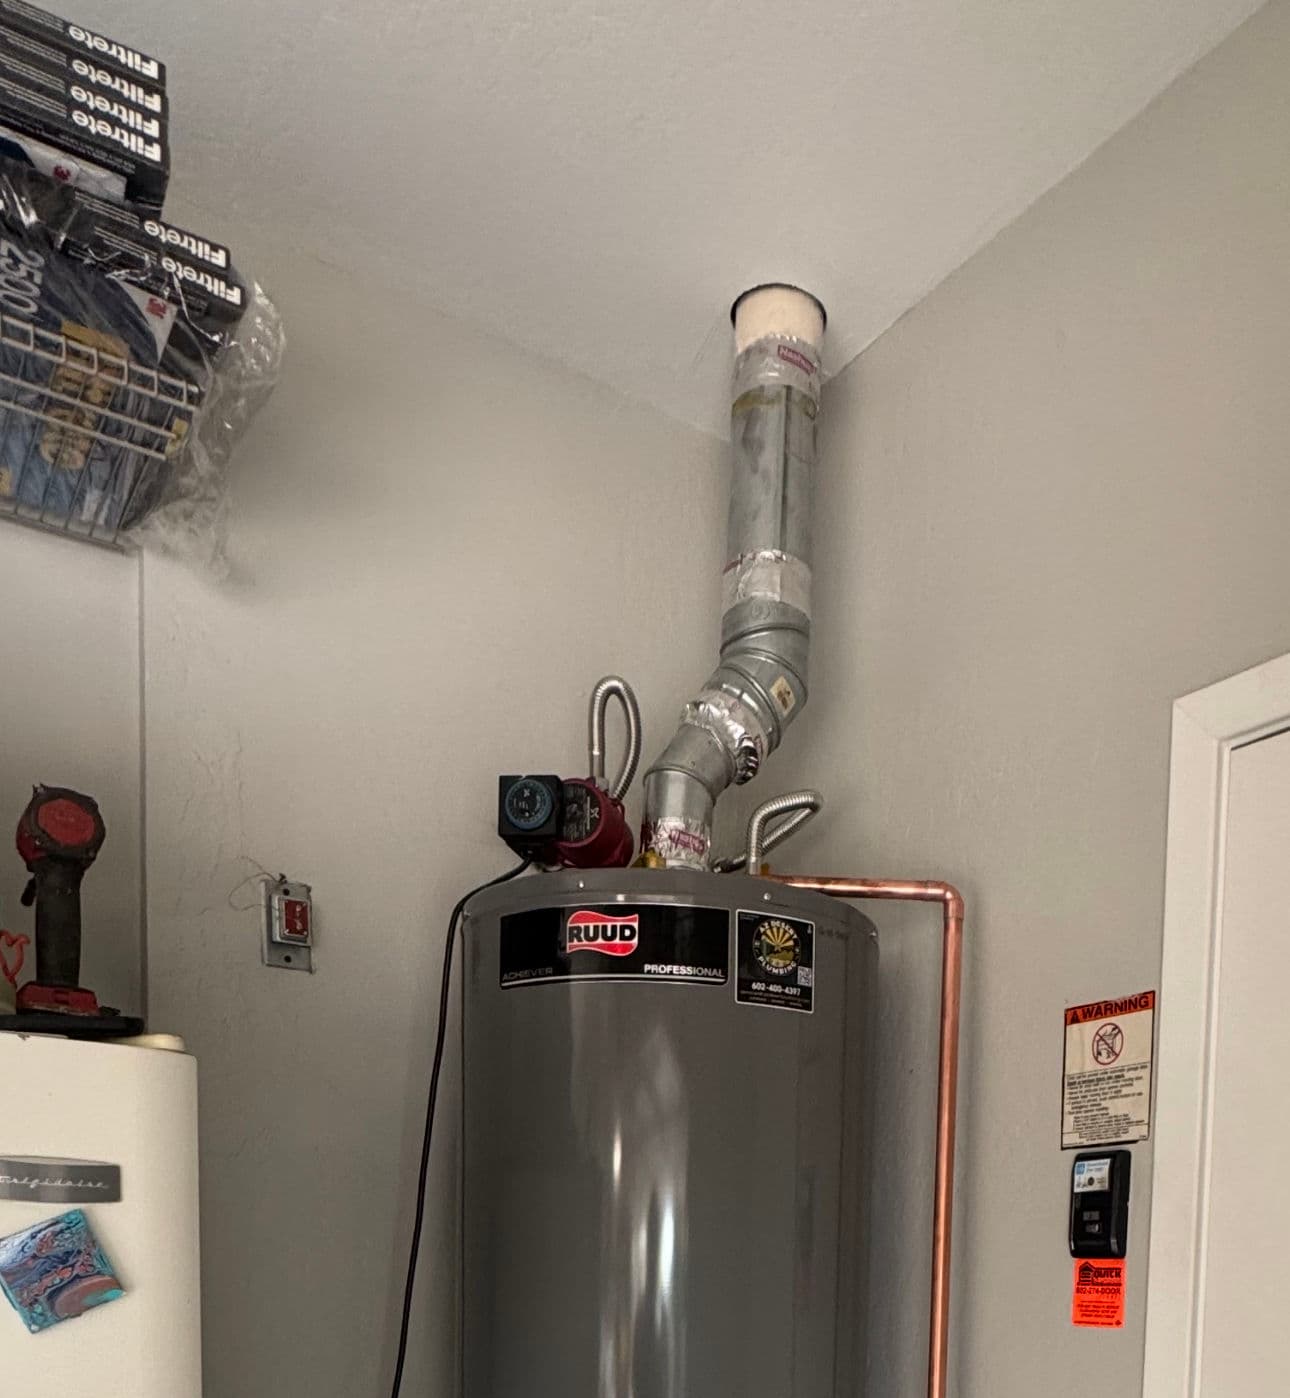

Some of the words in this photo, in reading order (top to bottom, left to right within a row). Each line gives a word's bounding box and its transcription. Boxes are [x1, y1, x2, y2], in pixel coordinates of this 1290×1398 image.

[68, 25, 159, 79] Filtrete
[72, 59, 162, 113] Filtrete
[70, 85, 160, 138] Filtrete
[72, 110, 162, 162] Filtrete
[144, 220, 227, 268] Filtrete
[161, 256, 242, 306] Filtrete
[568, 923, 637, 944] RUUD
[502, 967, 553, 982] ACHIEVER
[643, 963, 725, 978] PROFESSIONAL
[1082, 995, 1150, 1020] WARNING
